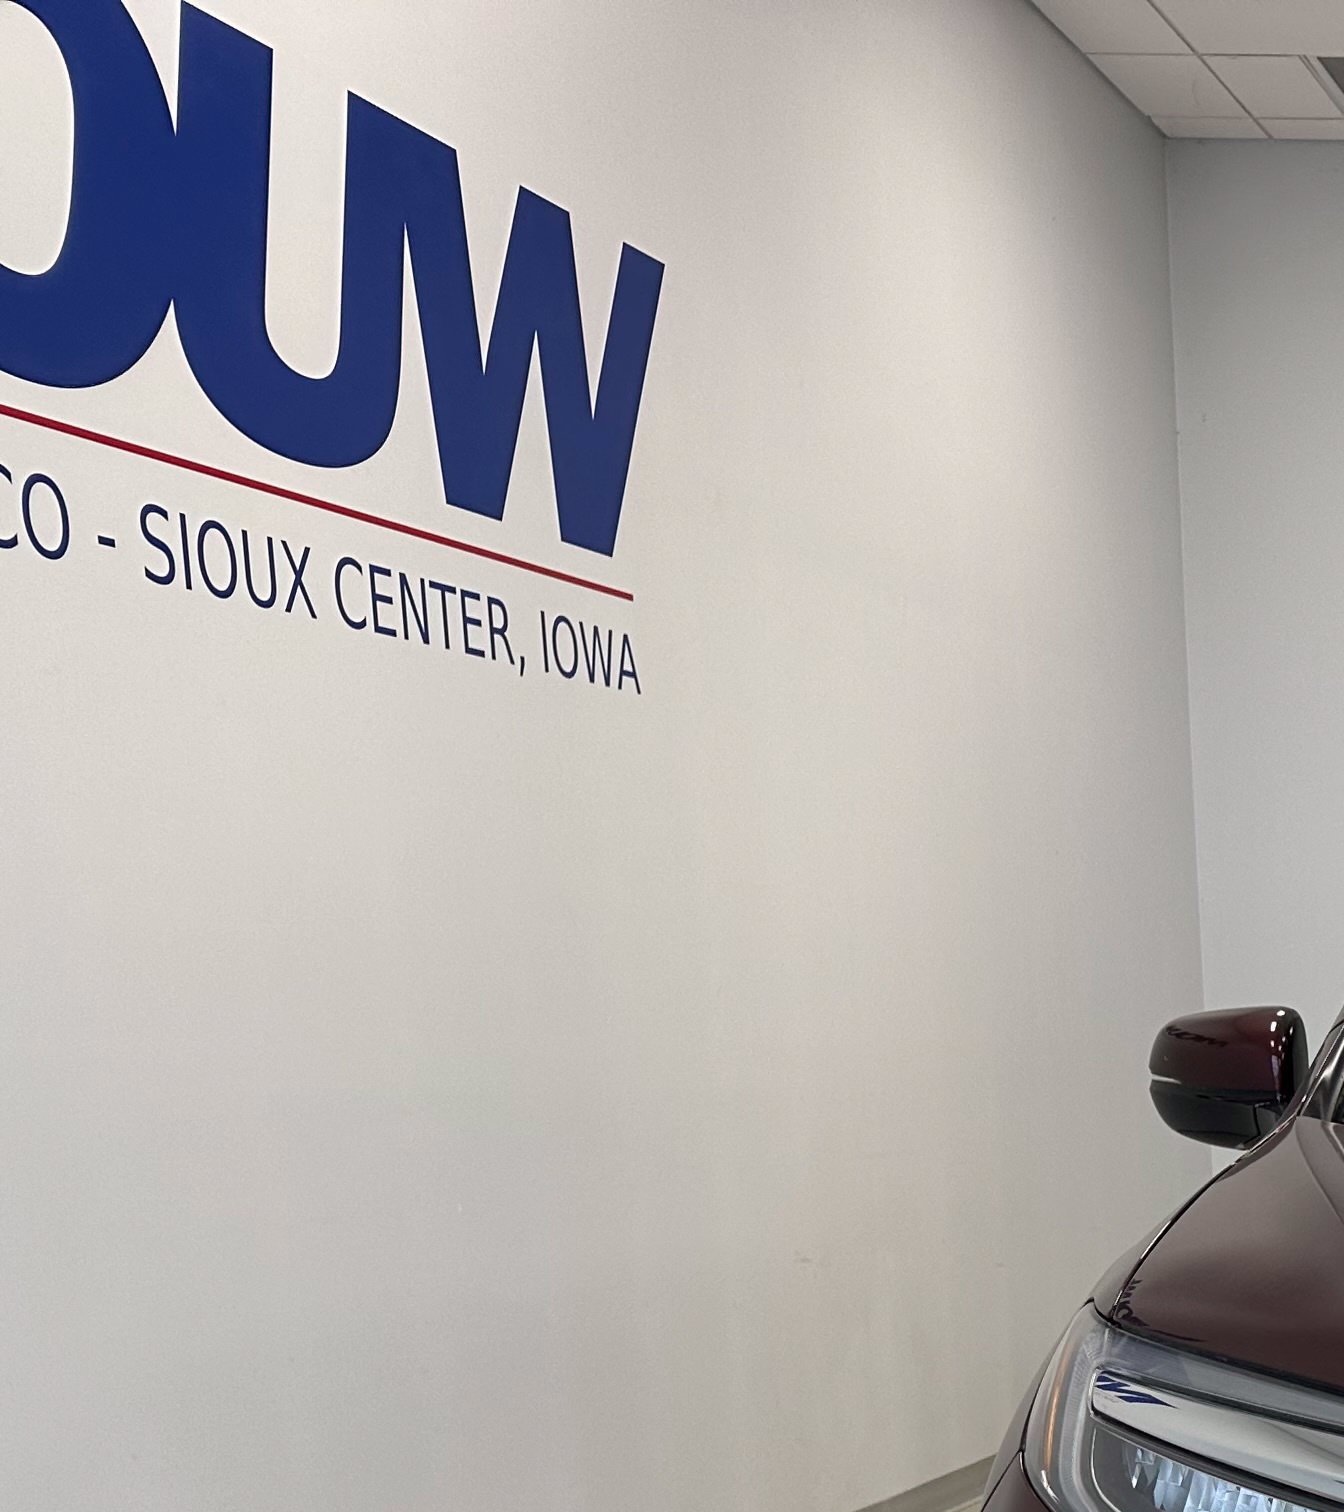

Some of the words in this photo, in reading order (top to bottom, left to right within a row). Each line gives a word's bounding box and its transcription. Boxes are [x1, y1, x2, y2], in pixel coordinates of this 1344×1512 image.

[139, 504, 318, 620] SIOUX
[334, 556, 526, 677] CENTER,
[540, 610, 642, 695] IOWA
